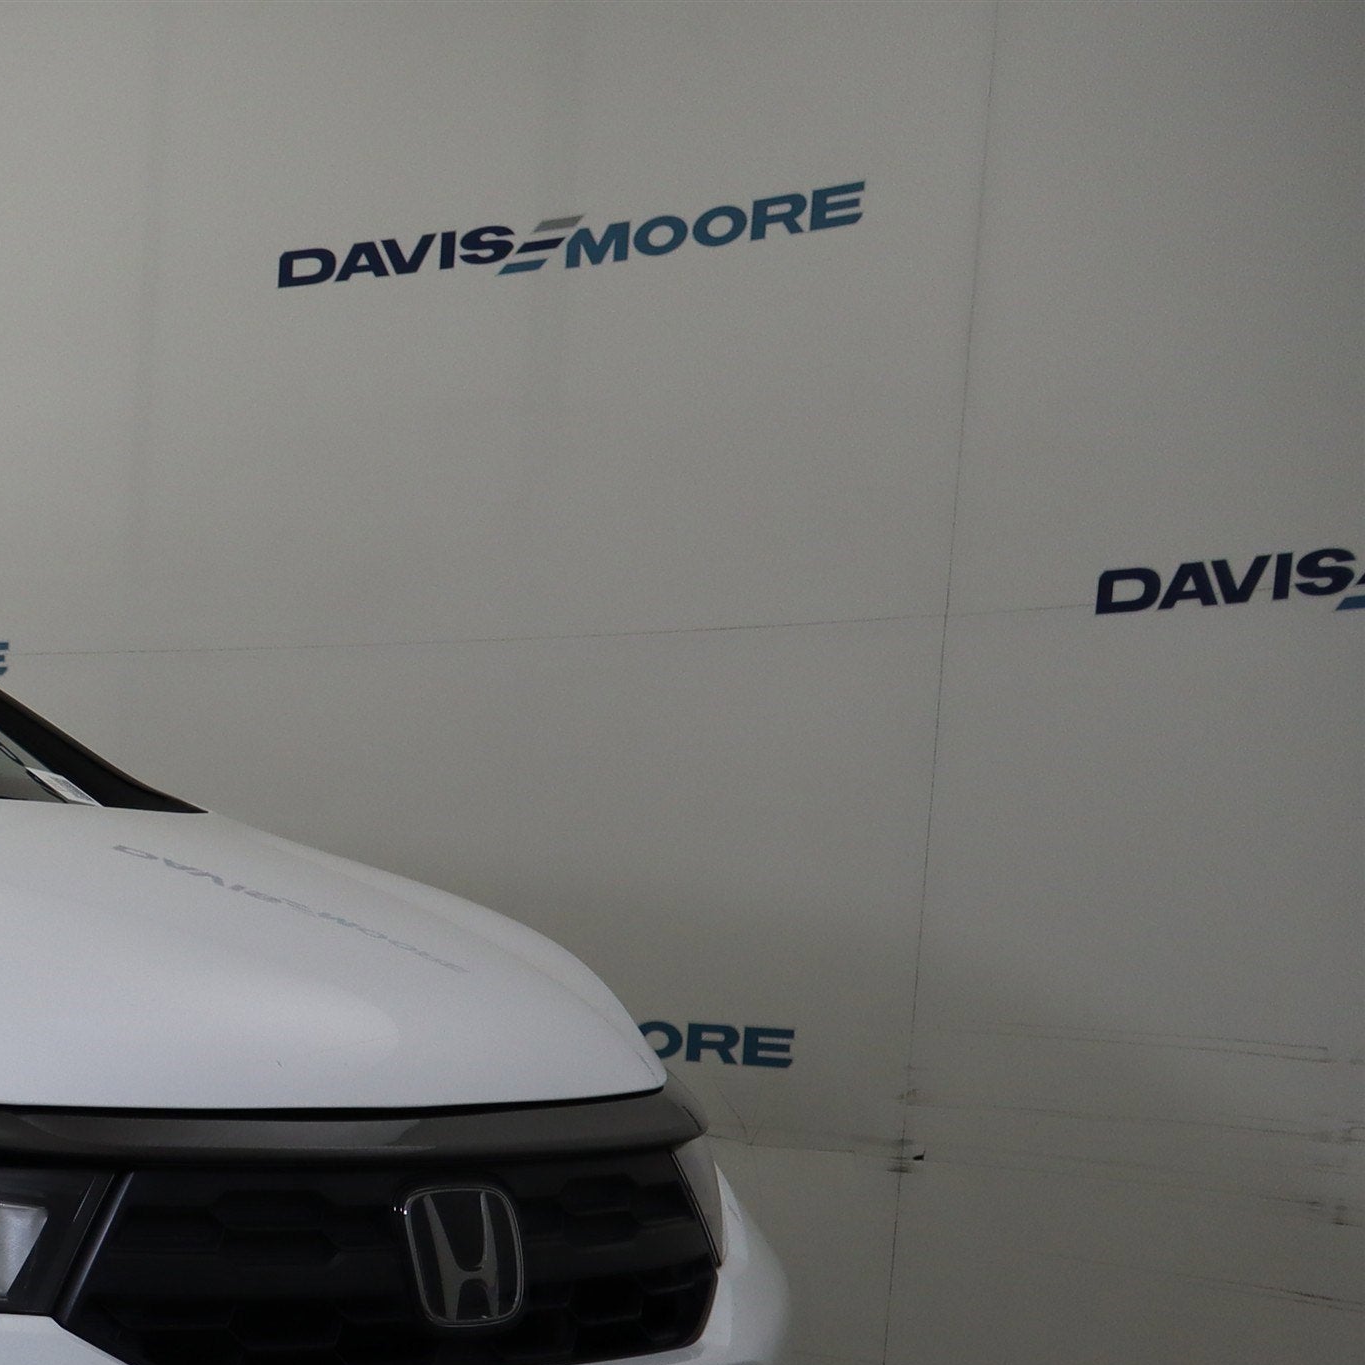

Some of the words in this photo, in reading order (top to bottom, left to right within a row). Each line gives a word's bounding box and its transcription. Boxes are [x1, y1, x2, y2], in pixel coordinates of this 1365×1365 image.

[277, 225, 516, 289] DAVIS
[565, 180, 866, 269] MOORE
[1095, 547, 1356, 615] DAVIS
[638, 1020, 795, 1068] ORE
